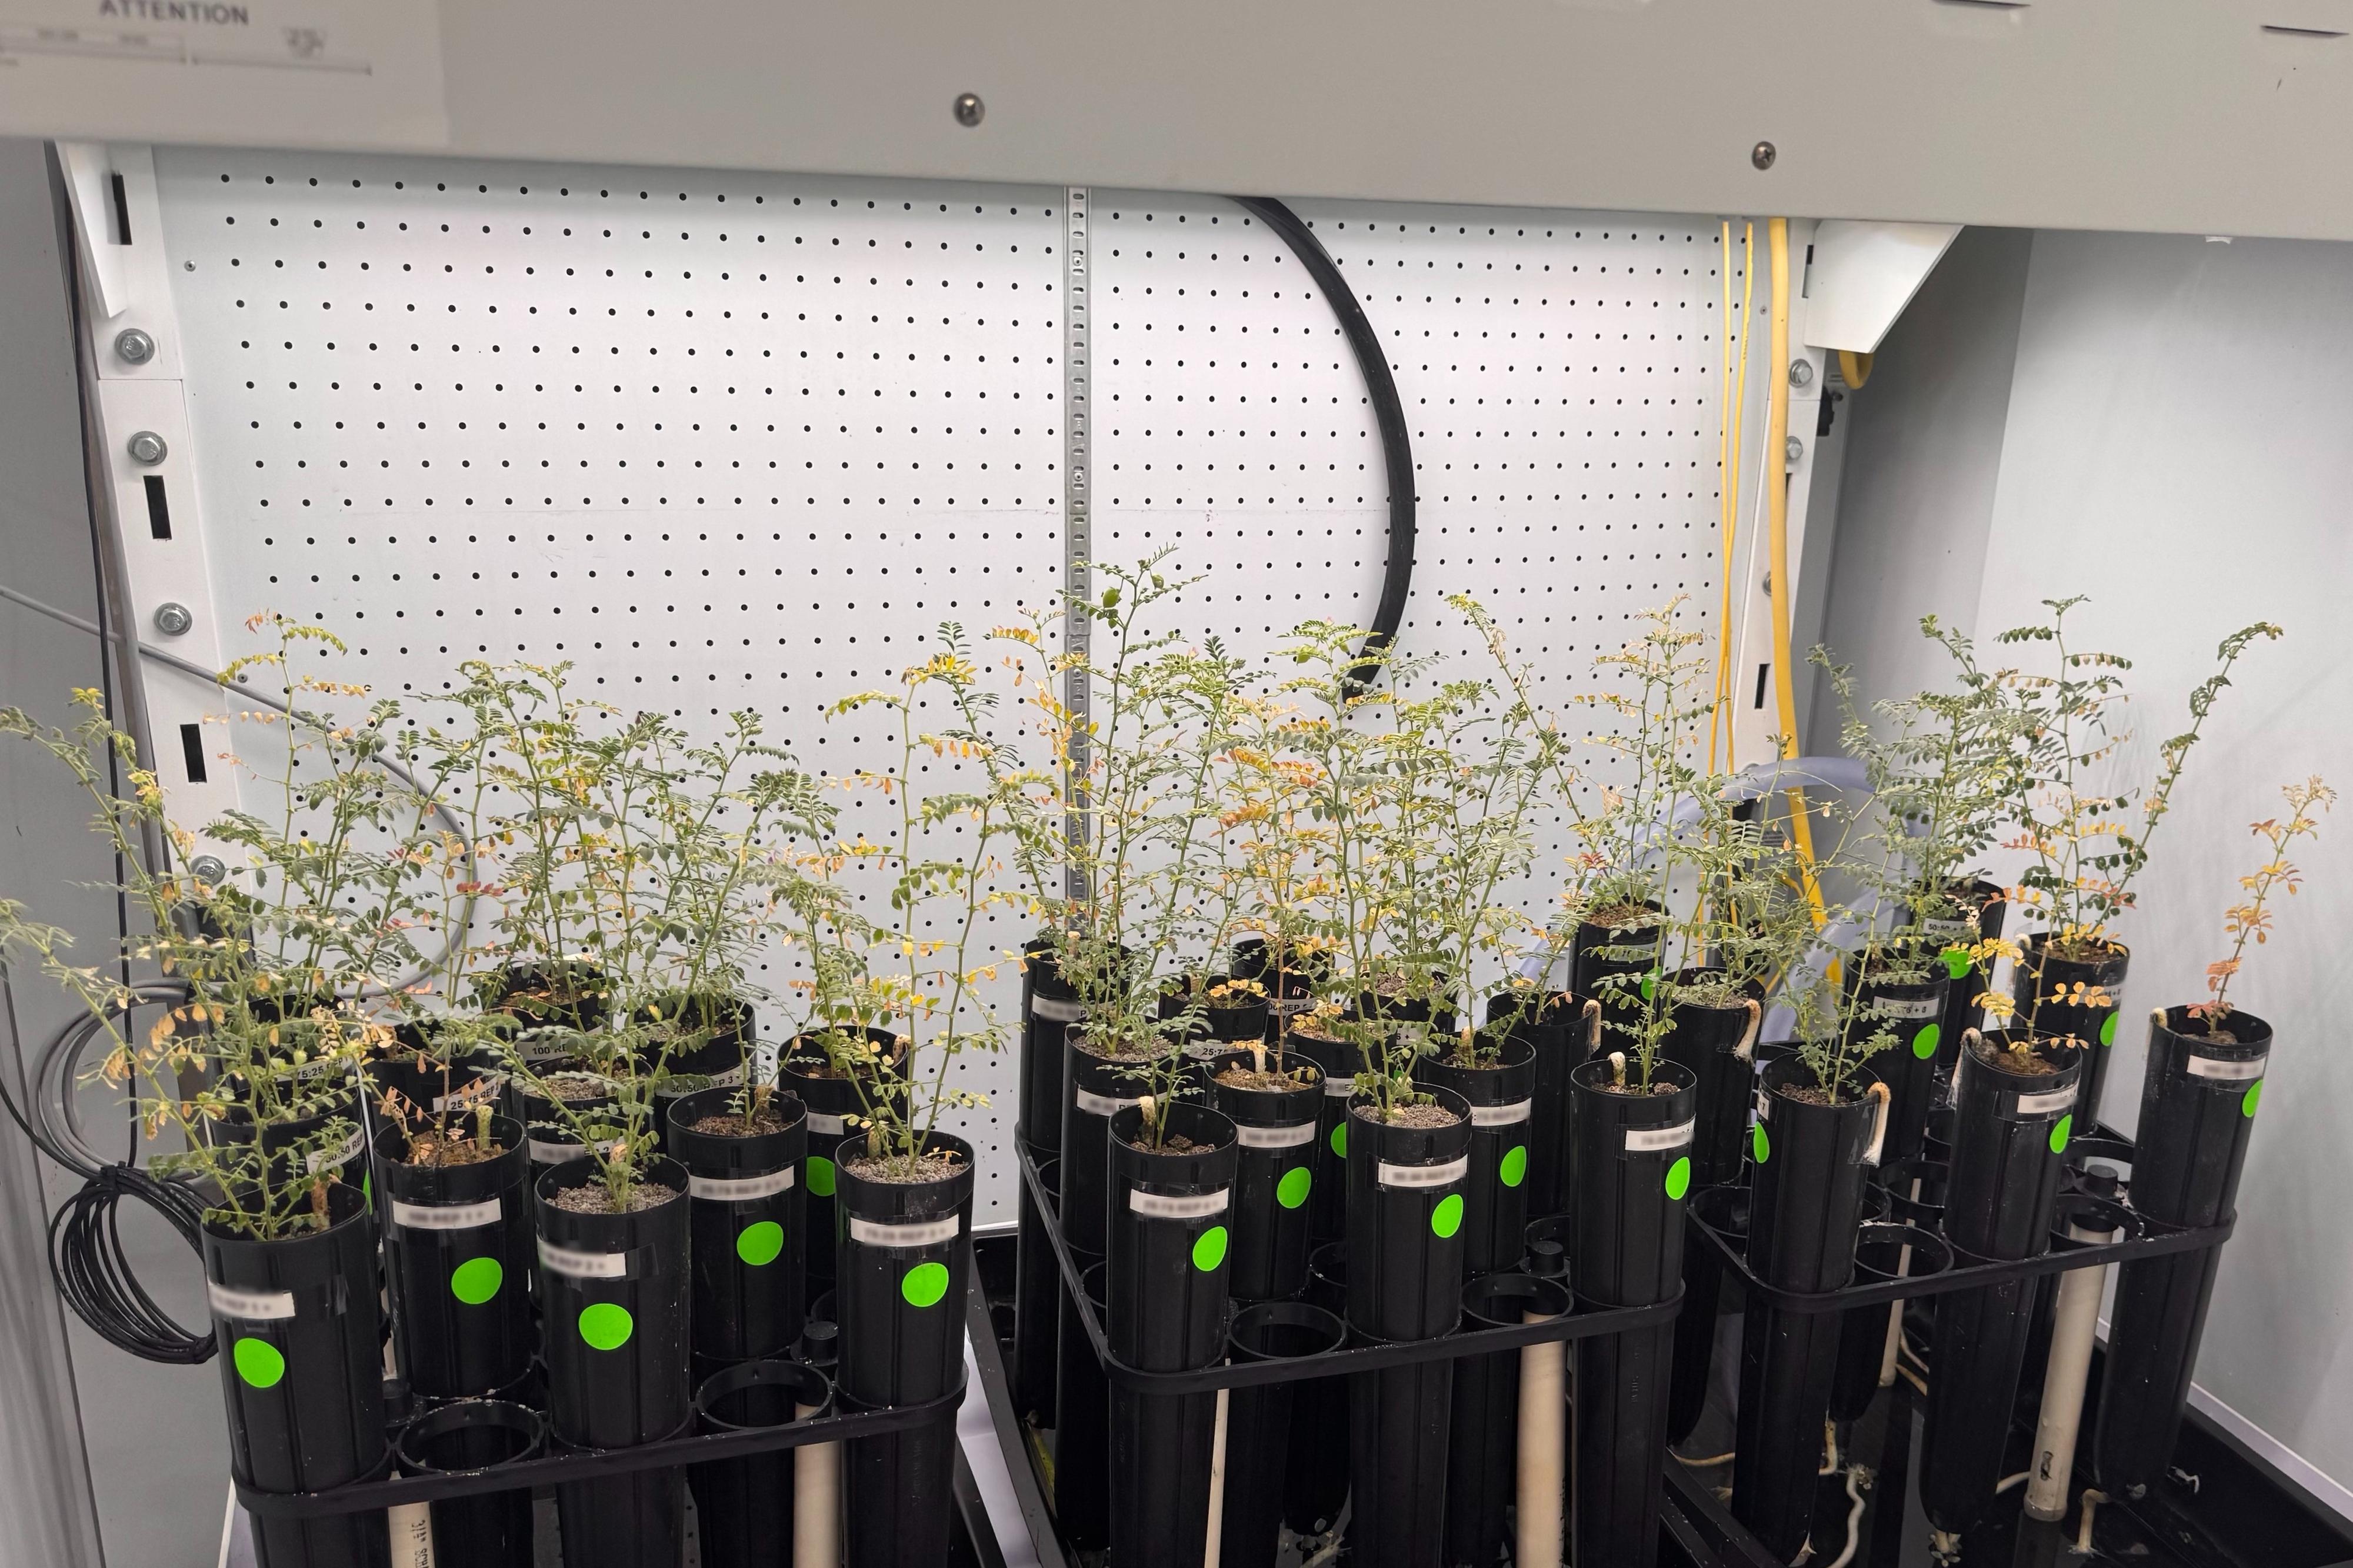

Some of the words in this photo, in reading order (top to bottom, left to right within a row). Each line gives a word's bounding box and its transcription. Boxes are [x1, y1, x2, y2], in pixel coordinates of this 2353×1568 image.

[99, 0, 249, 26] ATTENTION
[532, 1046, 551, 1055] 100
[297, 1066, 324, 1079] 5:25
